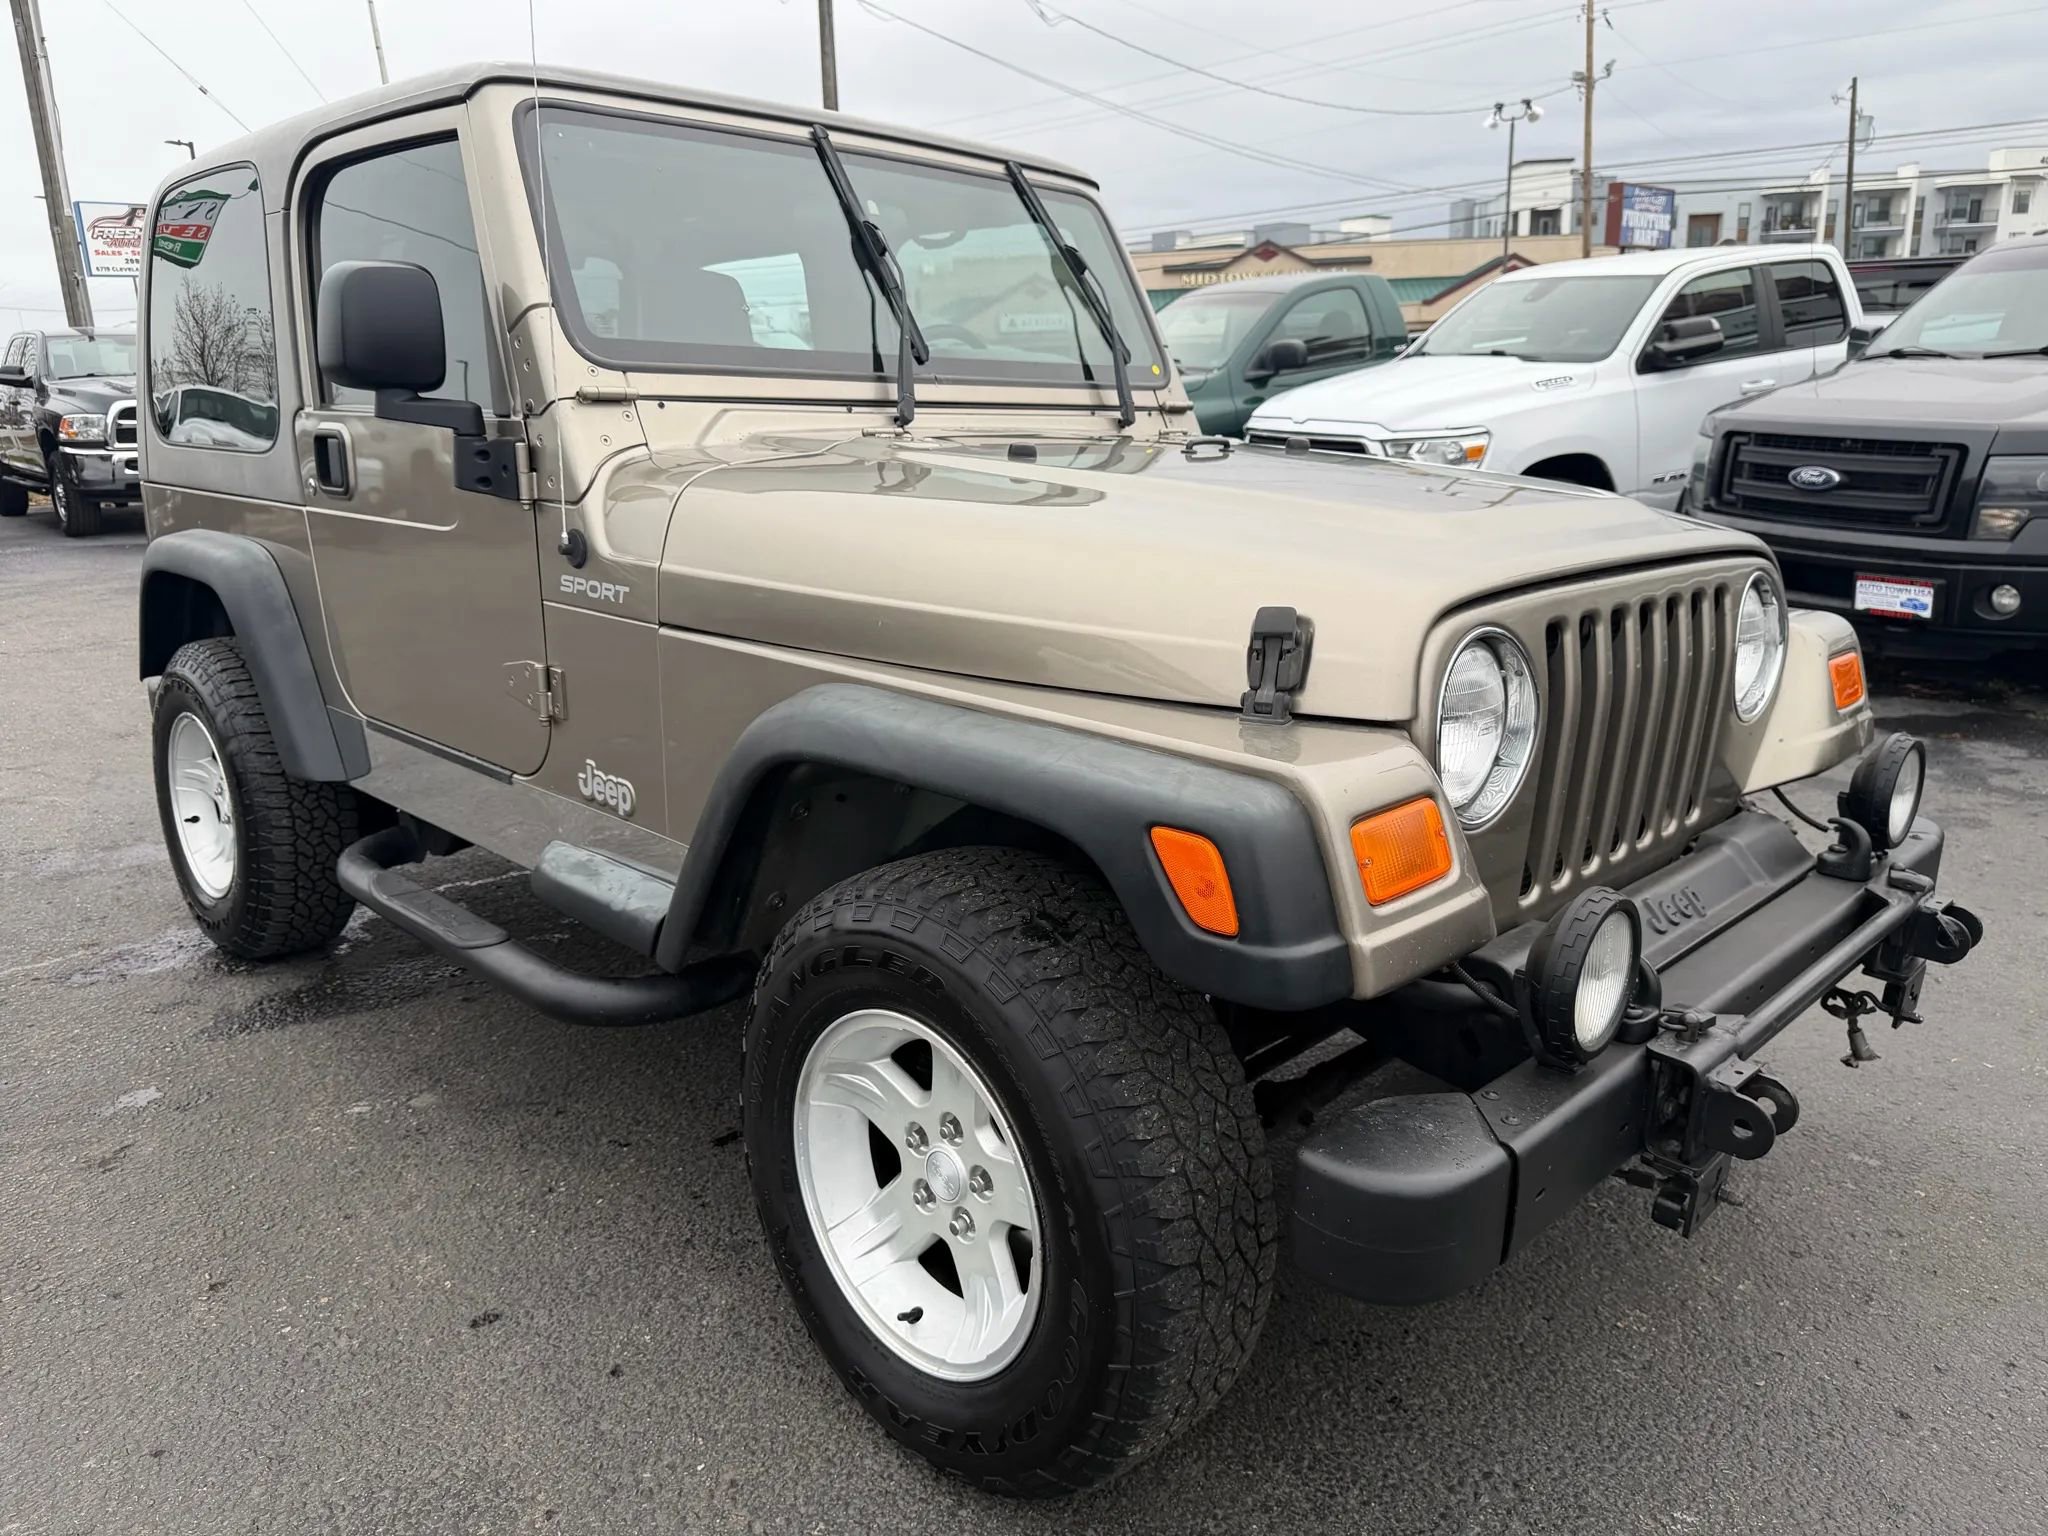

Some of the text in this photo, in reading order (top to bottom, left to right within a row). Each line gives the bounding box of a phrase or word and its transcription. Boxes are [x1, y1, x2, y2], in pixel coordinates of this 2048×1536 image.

[1797, 469, 1828, 483] Ford
[560, 575, 630, 603] SPORT
[1859, 583, 1882, 591] AUTO
[1885, 586, 1911, 595] TOWN
[578, 759, 636, 817] Jeep
[1641, 886, 1707, 935] Jeep
